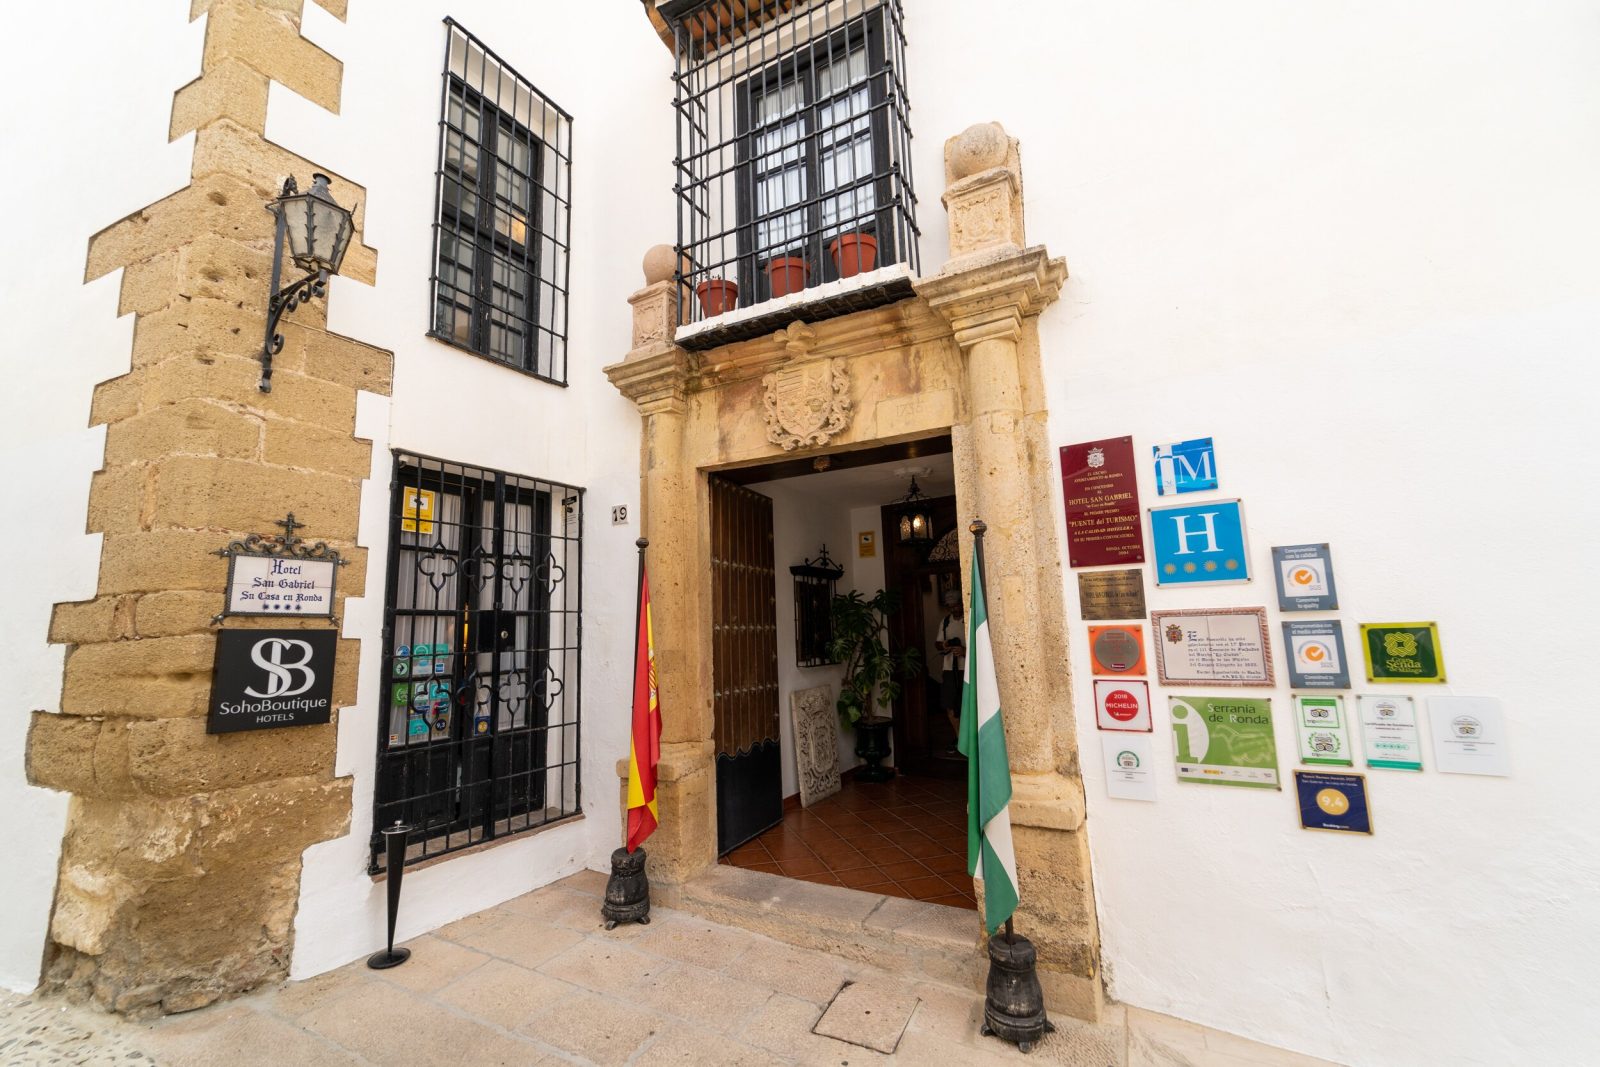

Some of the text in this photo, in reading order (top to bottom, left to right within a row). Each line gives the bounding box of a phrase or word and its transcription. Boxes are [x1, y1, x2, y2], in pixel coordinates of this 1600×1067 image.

[1104, 492, 1133, 500] GABRIEL
[613, 506, 627, 522] 19
[1069, 519, 1095, 527] "PUENTE
[1105, 515, 1138, 524] TURISMO"
[1169, 511, 1224, 555] H
[270, 558, 302, 576] Hotel
[252, 576, 315, 590] San Gabriel
[257, 591, 281, 602] Casa
[283, 594, 293, 602] en
[295, 593, 323, 603] Ronda
[1386, 658, 1421, 669] Senda
[219, 697, 328, 717] SohoBoutique
[256, 712, 295, 724] HOTELS
[1208, 713, 1269, 725] de Ronda
